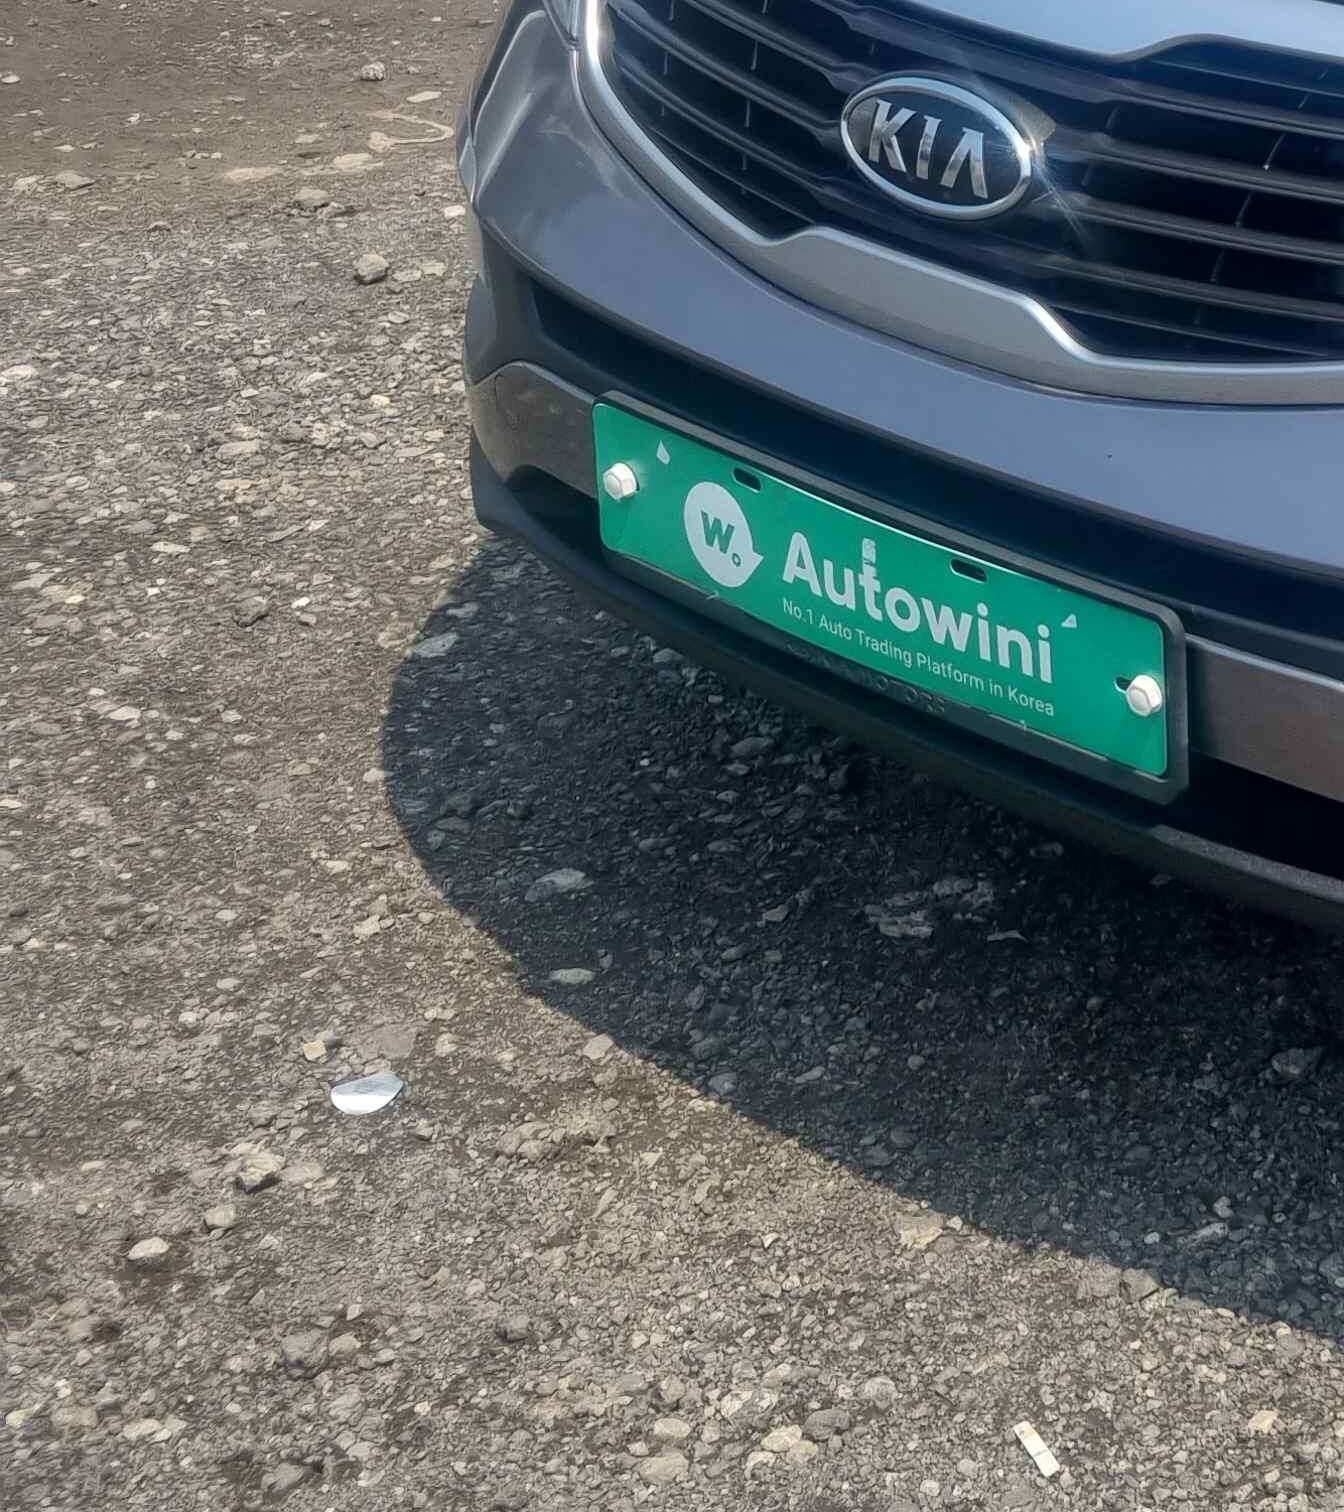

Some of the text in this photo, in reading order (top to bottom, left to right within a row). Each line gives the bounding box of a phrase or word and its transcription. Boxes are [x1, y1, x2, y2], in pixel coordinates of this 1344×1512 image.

[868, 99, 989, 199] KIA
[782, 531, 1053, 683] Autowini
[818, 614, 853, 641] Auto
[855, 628, 913, 669] Trading
[916, 652, 985, 692] Platform
[989, 678, 1004, 698] in
[1007, 687, 1055, 718] Korea
